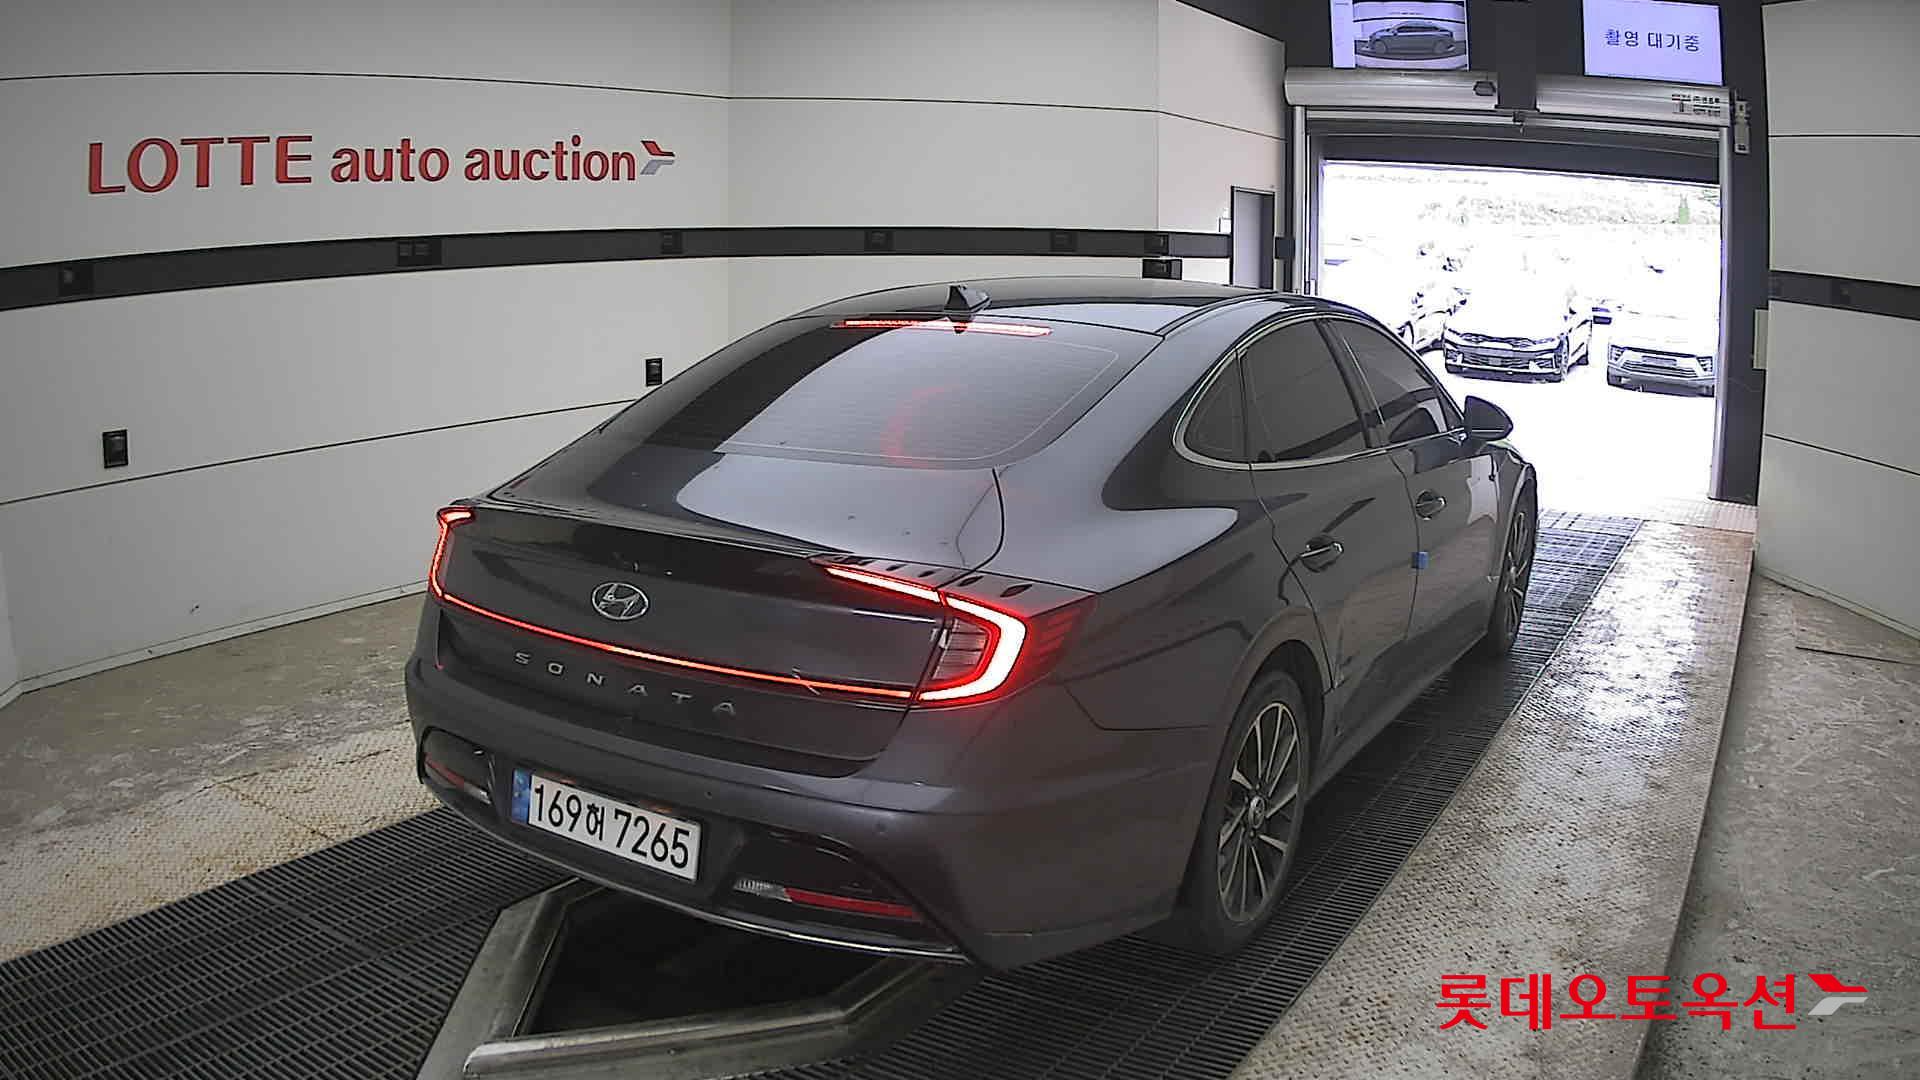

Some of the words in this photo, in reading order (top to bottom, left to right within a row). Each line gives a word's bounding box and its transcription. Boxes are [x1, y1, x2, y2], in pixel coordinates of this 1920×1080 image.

[1647, 32, 1699, 52] 대기중
[87, 135, 313, 195] LOTTE
[330, 138, 450, 183] auto
[464, 135, 637, 182] auction
[515, 652, 736, 716] SONATA
[535, 784, 605, 841] 169허
[614, 808, 690, 869] 7265
